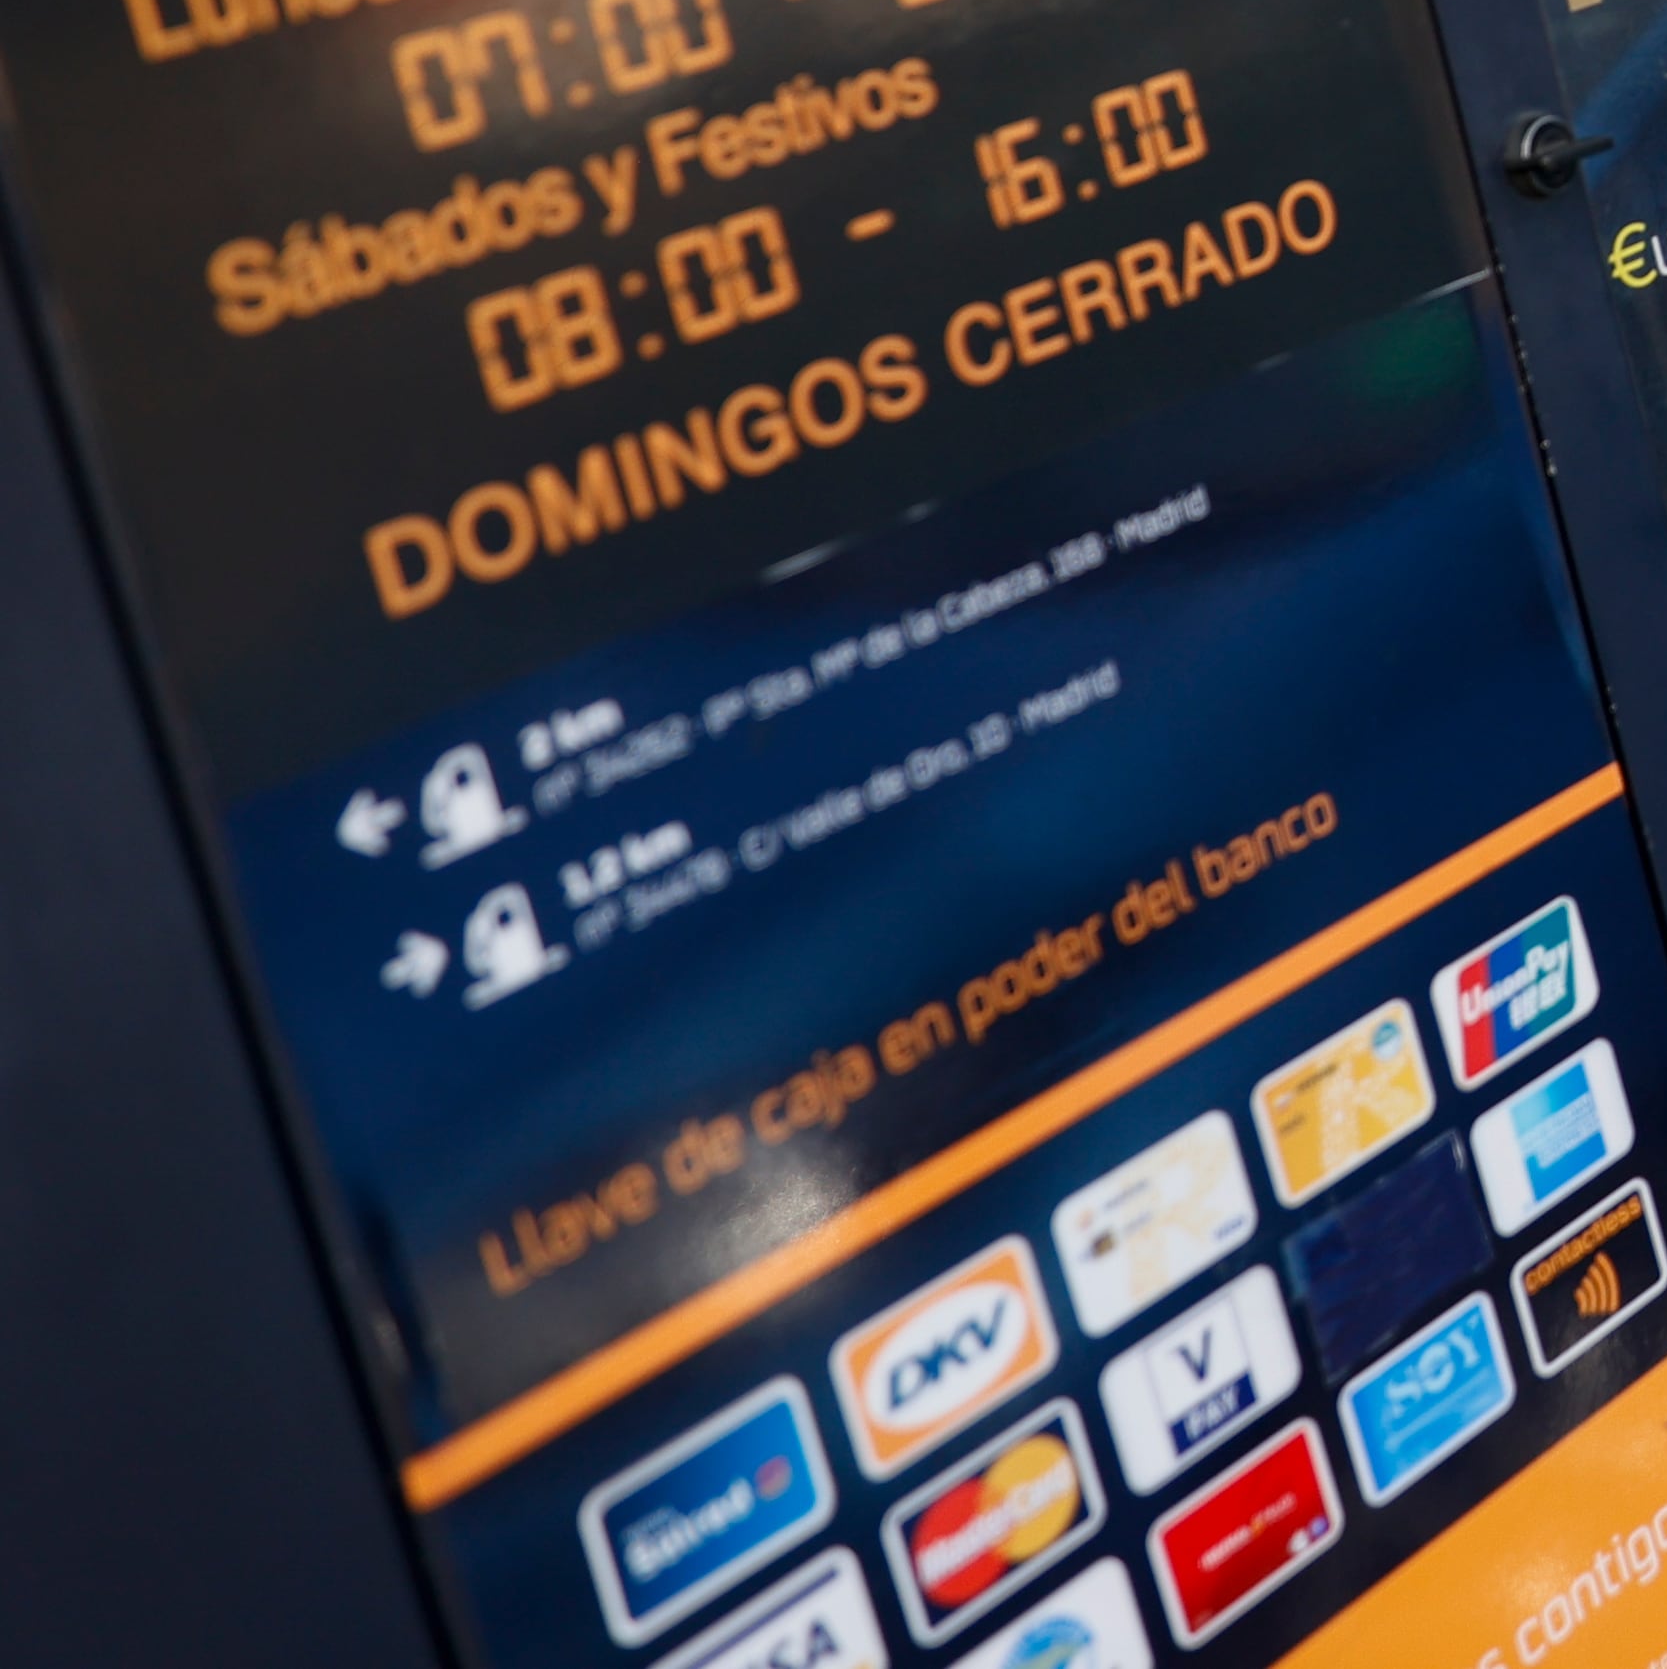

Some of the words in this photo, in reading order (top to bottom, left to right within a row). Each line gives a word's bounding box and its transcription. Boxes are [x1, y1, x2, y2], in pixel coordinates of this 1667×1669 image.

[206, 159, 583, 338] Sábados
[583, 146, 639, 239] y
[646, 55, 940, 198] Festivos
[465, 206, 802, 414] 08:00
[974, 68, 1209, 230] 16:00
[363, 333, 930, 622] DOMINGOS
[943, 178, 1340, 390] CERRADO
[1112, 483, 1212, 553] Madrid
[1017, 657, 1122, 734] Madrid
[1460, 939, 1569, 1024] UnionPay
[477, 1157, 661, 1299] Llave
[658, 1117, 747, 1196] de
[748, 1041, 878, 1143] caja
[877, 998, 955, 1078] en
[954, 921, 1106, 1045] poder
[1108, 857, 1193, 949] del
[1191, 789, 1339, 901] banco
[1523, 1194, 1643, 1297] contactless
[887, 1293, 1010, 1414] DKV
[1173, 1323, 1213, 1383] V
[1182, 1377, 1242, 1441] PAY
